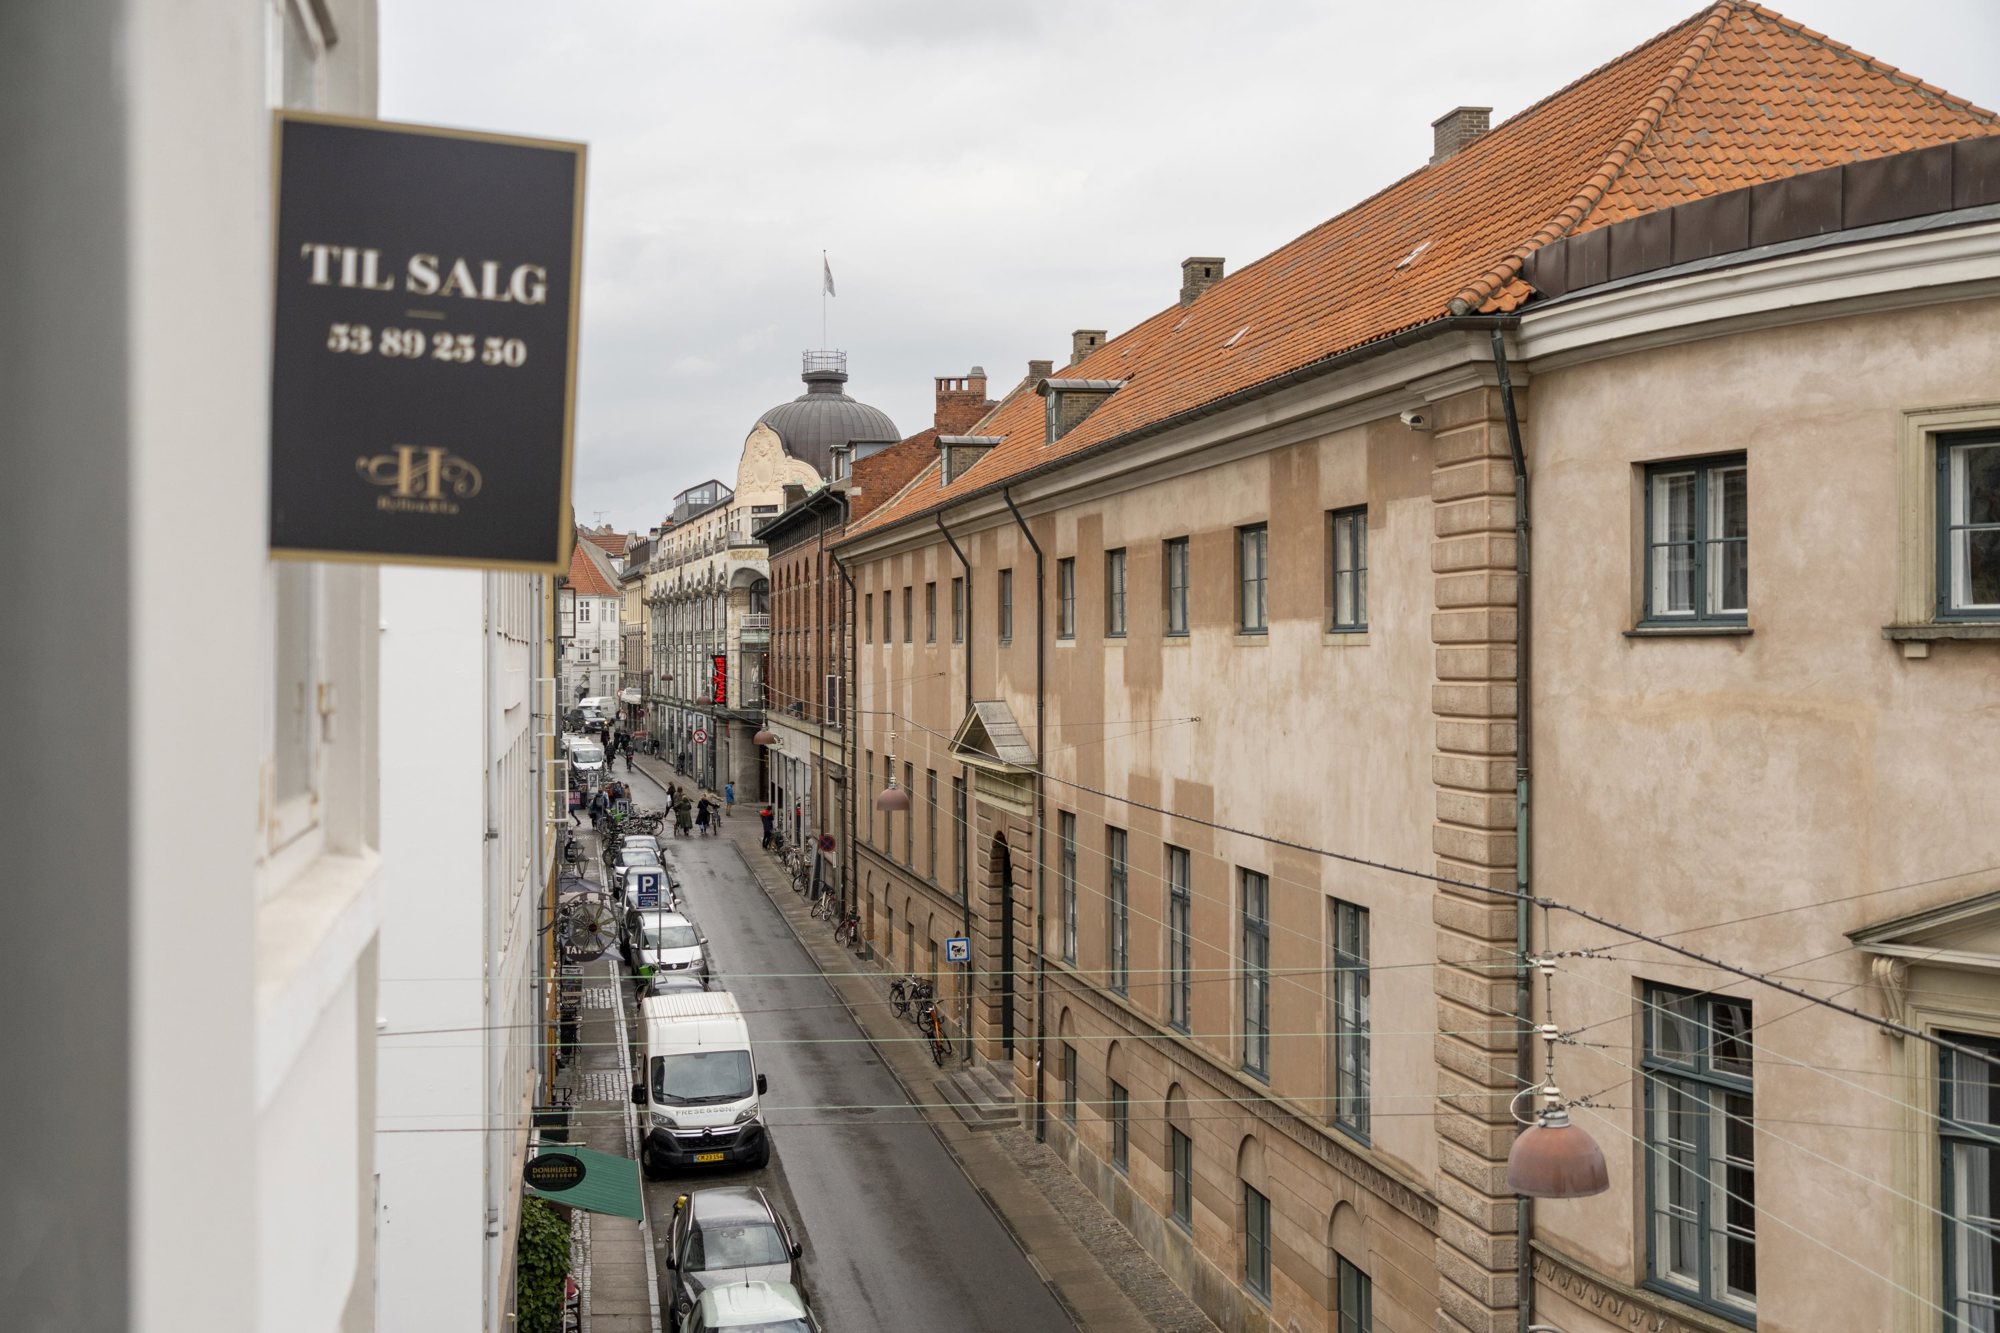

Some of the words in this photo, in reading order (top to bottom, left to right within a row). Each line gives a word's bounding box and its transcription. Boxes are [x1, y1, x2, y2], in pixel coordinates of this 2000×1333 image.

[301, 243, 395, 291] TIL
[406, 252, 548, 305] SALG
[327, 323, 373, 354] 53
[379, 327, 426, 358] 89
[432, 331, 476, 363] 25
[481, 336, 527, 367] 50
[642, 876, 654, 892] P
